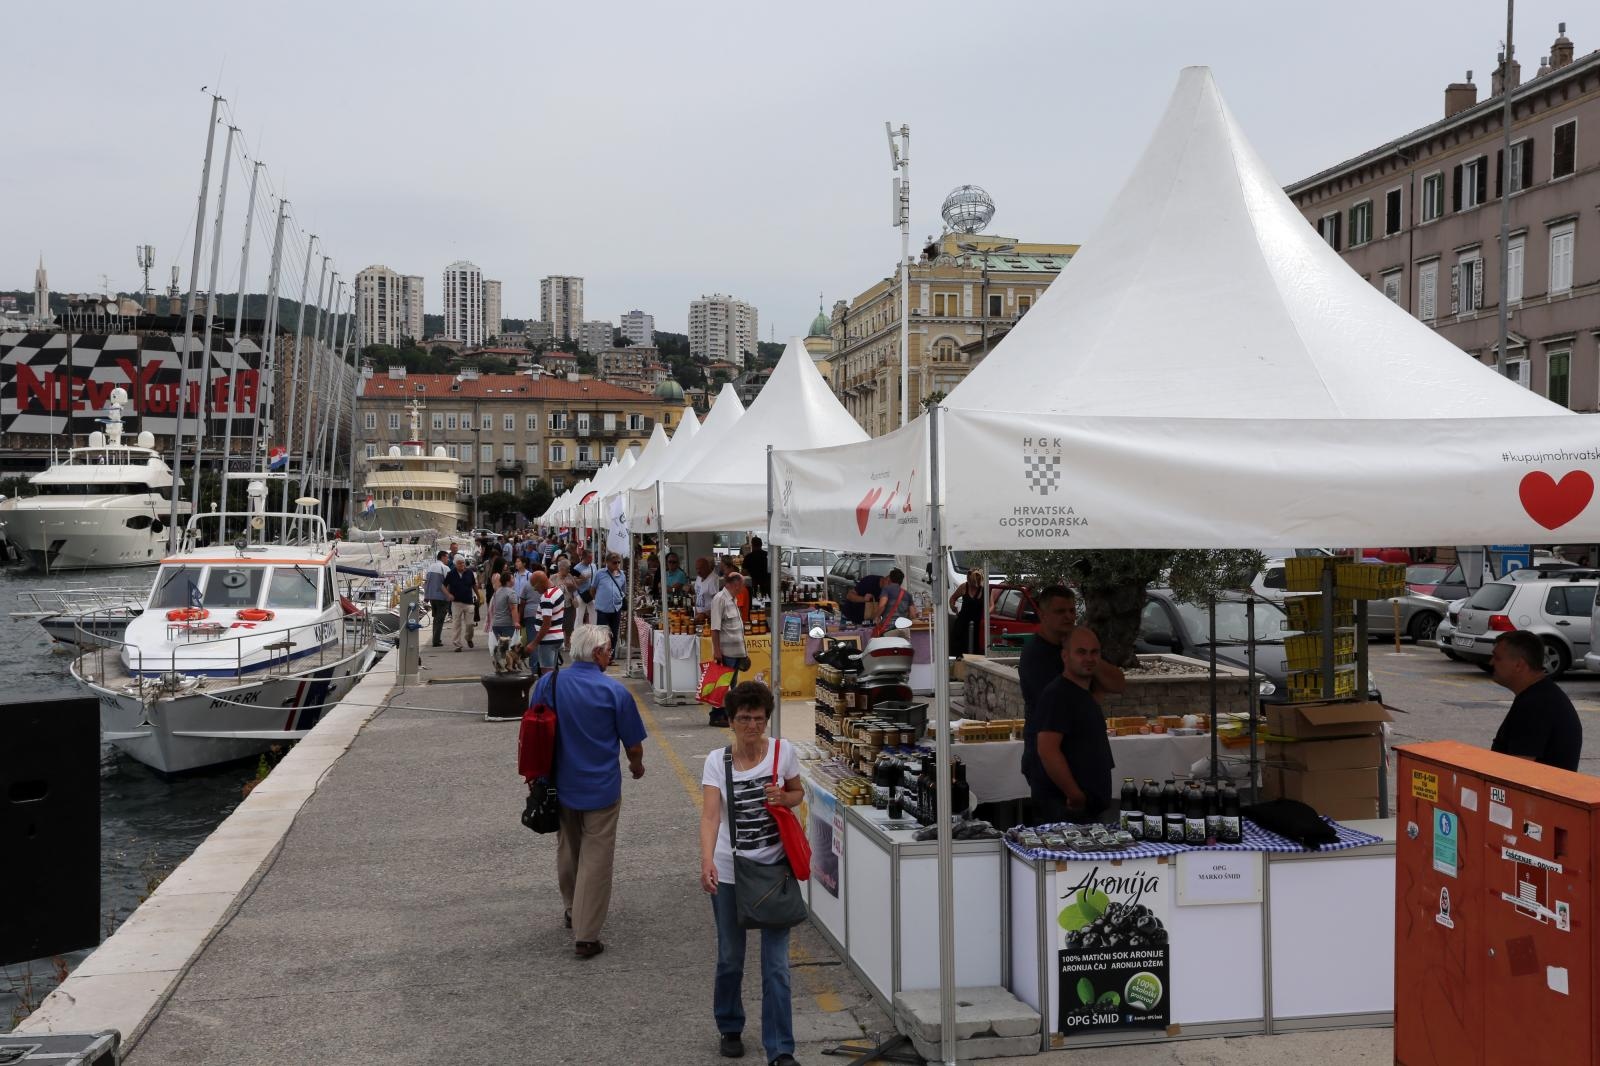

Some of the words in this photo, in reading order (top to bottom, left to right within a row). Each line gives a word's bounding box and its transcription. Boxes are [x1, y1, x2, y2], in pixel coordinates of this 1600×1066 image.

[1013, 506, 1075, 516] HRVATSKA
[999, 517, 1089, 527] GOSPODARSKA
[1017, 528, 1070, 538] KOMORA
[1060, 866, 1160, 918] Aronija
[1062, 955, 1081, 963] 100%
[1081, 952, 1111, 962] MATIČNI
[1112, 951, 1129, 960] SOK
[1130, 950, 1164, 959] ARONIJE
[1062, 964, 1093, 973] ARONIJA
[1093, 962, 1107, 971] ČAJ
[1111, 961, 1142, 970] ARONIJA
[1142, 959, 1164, 968] DŽEM
[1136, 978, 1156, 991] 100%
[1130, 992, 1154, 1004] proizvod
[1067, 1015, 1090, 1026] OPG
[1092, 1012, 1119, 1025] ŠMID
